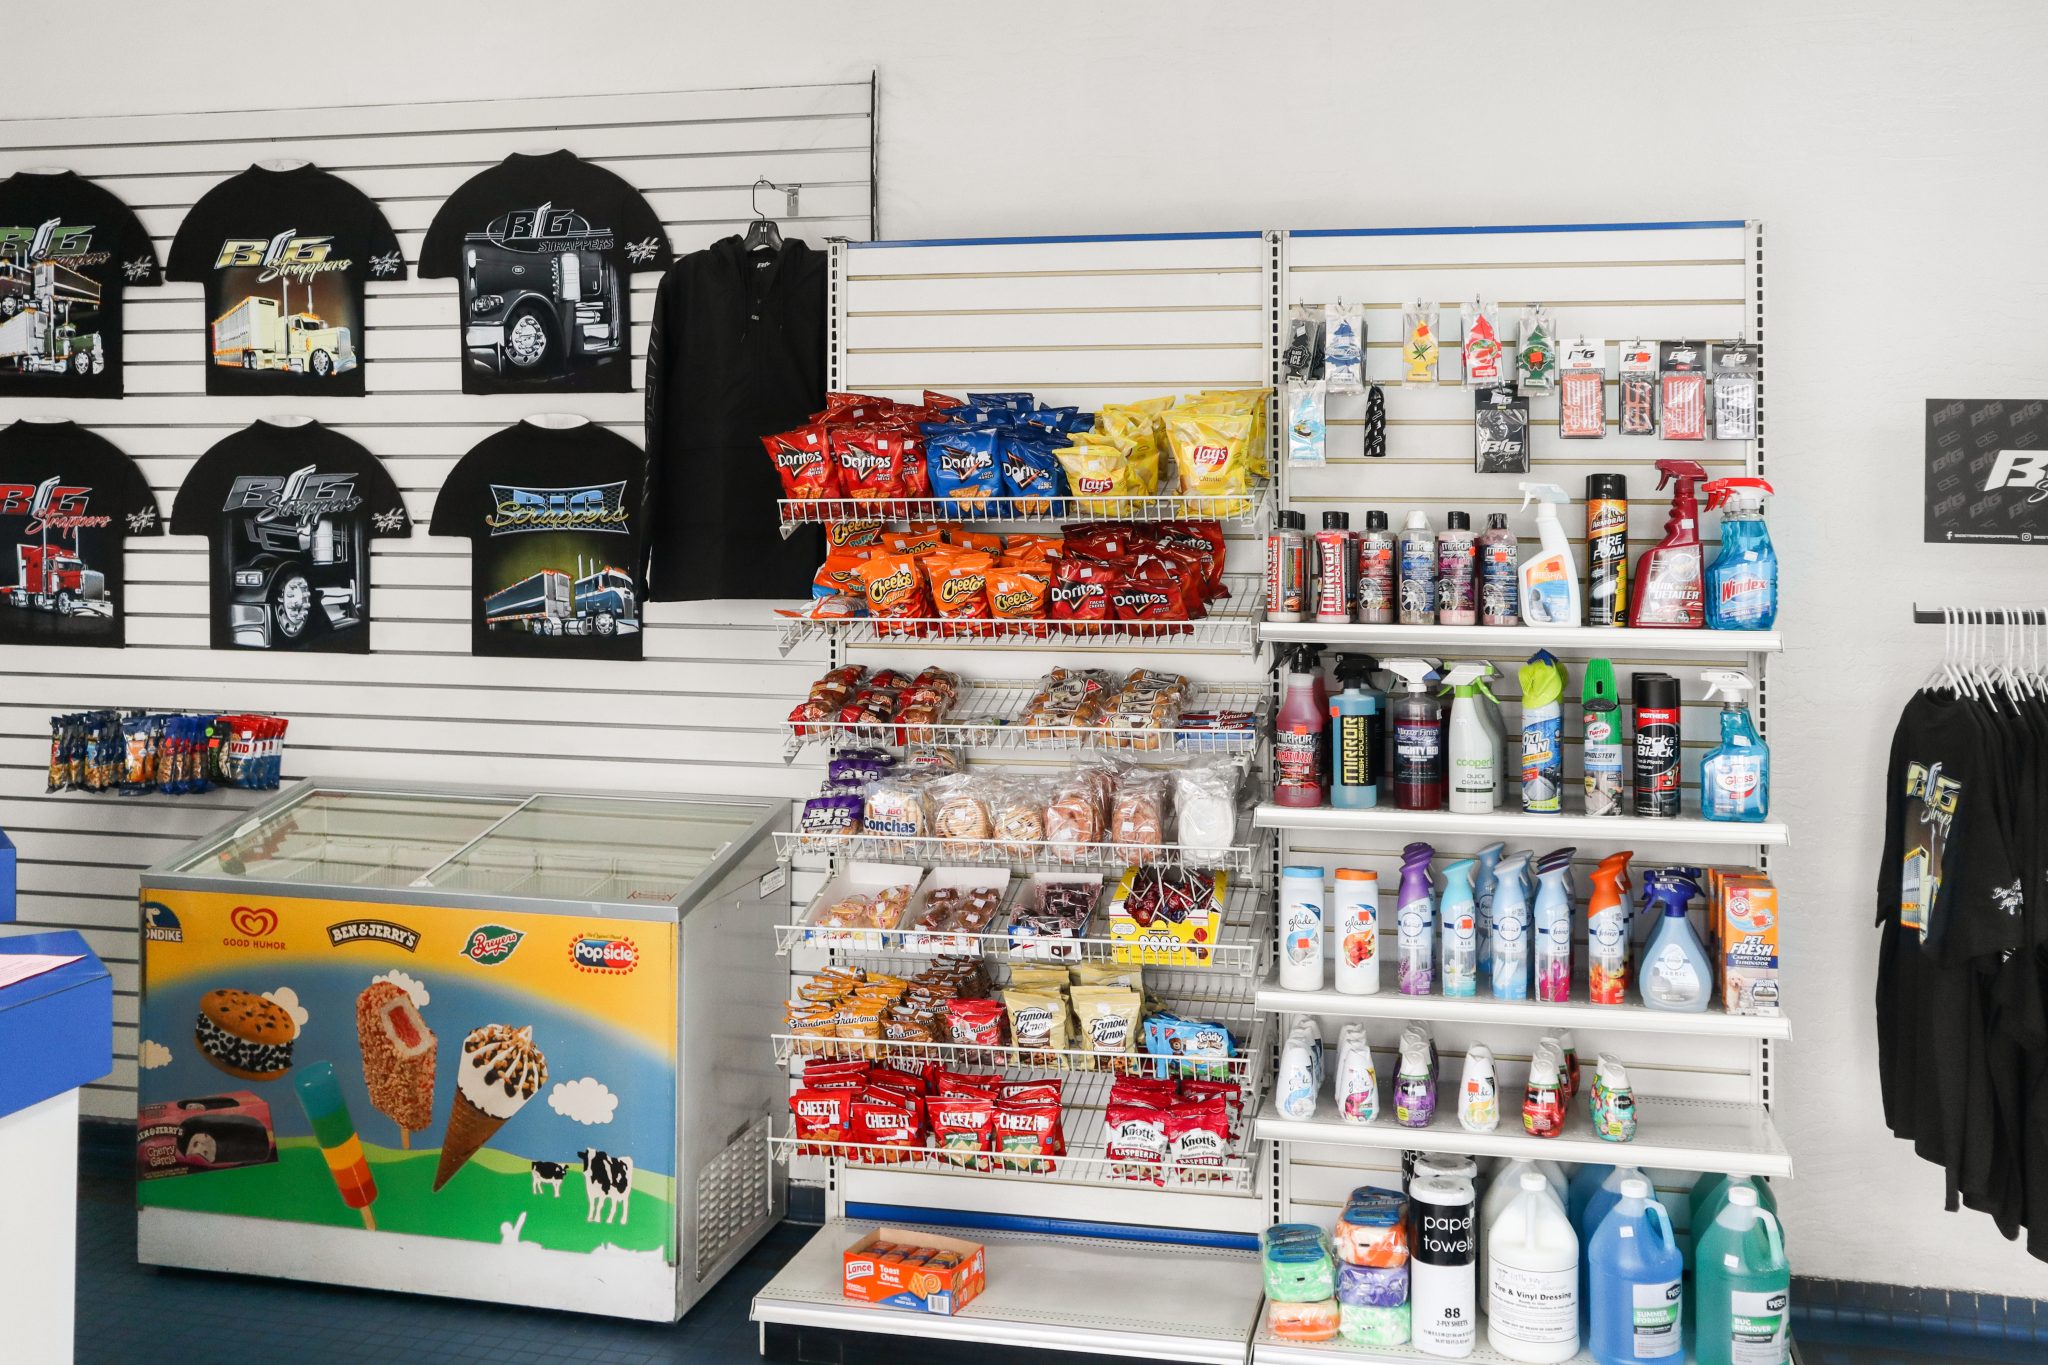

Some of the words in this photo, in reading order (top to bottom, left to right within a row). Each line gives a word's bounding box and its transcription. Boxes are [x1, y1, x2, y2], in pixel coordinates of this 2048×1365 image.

[502, 201, 575, 241] BIG
[214, 228, 334, 270] BIG
[538, 237, 614, 253] STRAPPERS
[256, 257, 353, 284] Strappers
[1485, 440, 1523, 453] BIG
[778, 451, 823, 467] Doritos
[841, 453, 891, 469] Doritos
[941, 454, 993, 472] Doritos
[1196, 446, 1228, 465] Lay's
[223, 464, 359, 511] BIG
[1080, 477, 1112, 493] Lay's
[256, 494, 364, 526] Strappers
[513, 489, 604, 515] BIG
[25, 508, 112, 535] Strappers
[486, 501, 628, 529] Strappers
[1597, 534, 1623, 548] TIRE
[1593, 545, 1625, 560] FOAM
[870, 571, 913, 603] Cheetos
[1051, 583, 1104, 603] Doritos
[1654, 590, 1700, 600] DETAILER
[1722, 579, 1767, 603] Windex
[1113, 593, 1168, 607] Doritos
[1216, 713, 1248, 721] Donuts
[1276, 732, 1313, 744] MIRROR
[1637, 734, 1668, 746] Back
[1343, 717, 1358, 784] MIRROR
[1397, 745, 1425, 755] MIGHTY
[1637, 745, 1674, 757] Black
[1906, 760, 1962, 816] BIG
[808, 808, 851, 819] BIG
[802, 817, 851, 828] TEXAS
[864, 816, 916, 833] Conchas
[1289, 915, 1316, 931] glade
[223, 938, 250, 948] GOOD
[252, 940, 286, 950] HUMOR
[470, 932, 518, 957] Breyers
[1138, 936, 1182, 952] POPS
[1743, 935, 1765, 945] PET
[575, 942, 634, 962] Popsicle
[1730, 943, 1774, 956] FRESH
[1013, 1010, 1053, 1027] Famous
[1088, 1018, 1128, 1035] Famous
[1092, 1030, 1124, 1043] Amos
[1196, 1031, 1224, 1043] Teddy
[1122, 1124, 1157, 1141] Knott's
[1182, 1135, 1217, 1149] Knott's
[147, 1145, 176, 1157] Cherry
[1115, 1148, 1159, 1160] RASPBERRY
[150, 1155, 176, 1167] Garcia
[1178, 1156, 1221, 1165] RASPBERRY
[1424, 1214, 1475, 1234] paper
[1424, 1235, 1474, 1253] towels
[848, 1263, 872, 1274] Lance
[879, 1264, 900, 1276] Toast
[880, 1273, 899, 1283] Chee
[1494, 1282, 1507, 1293] Tire
[1516, 1291, 1538, 1301] Vinyl
[1540, 1291, 1572, 1301] Dressing
[1444, 1307, 1461, 1319] 88
[1734, 1325, 1772, 1333] REMOVER
